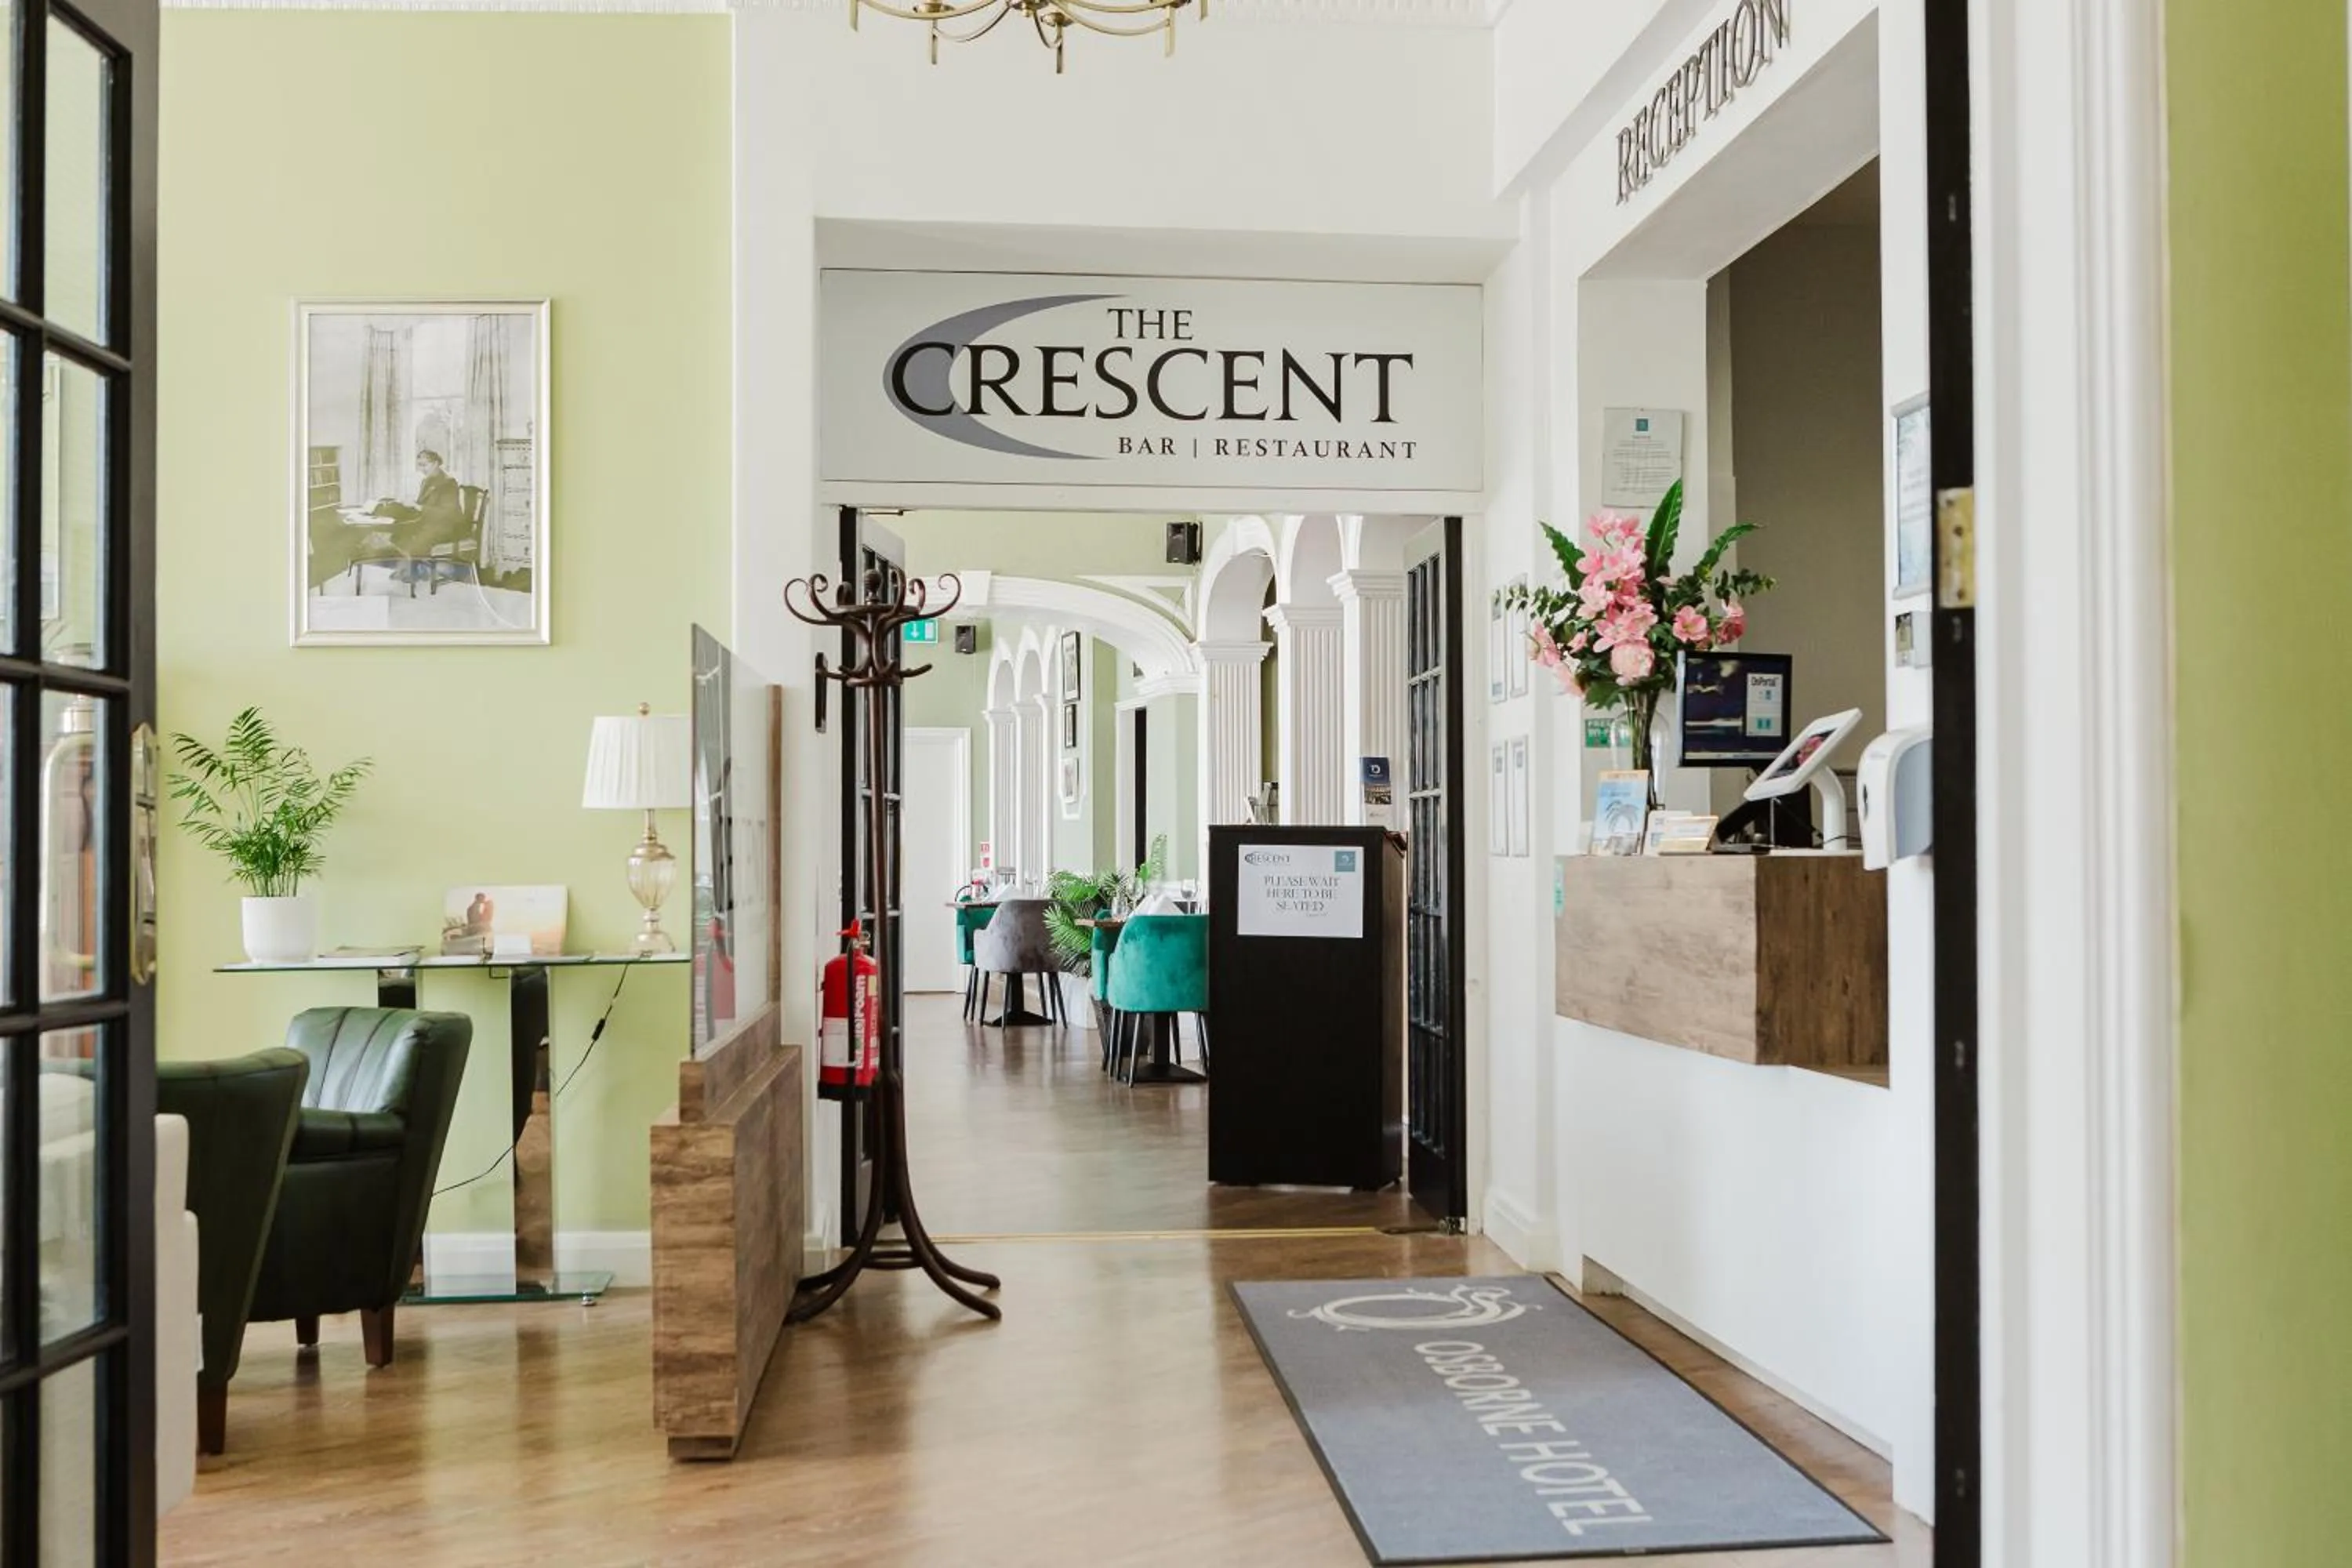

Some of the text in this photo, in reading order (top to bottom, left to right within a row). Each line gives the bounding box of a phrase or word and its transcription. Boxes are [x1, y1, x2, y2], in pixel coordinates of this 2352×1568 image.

[1616, 0, 1791, 206] RECEPTION
[1106, 307, 1194, 340] THE
[891, 340, 1414, 423] CRESCENT
[1117, 436, 1177, 456] BAR
[1214, 437, 1418, 459] RESTAURANT
[1264, 875, 1340, 887] PLEASE WAIT
[1265, 888, 1300, 899] HERE
[1301, 888, 1319, 899] TO
[1276, 901, 1325, 912] SEATED
[1414, 1340, 1655, 1537] OSBORNE HOTEL
